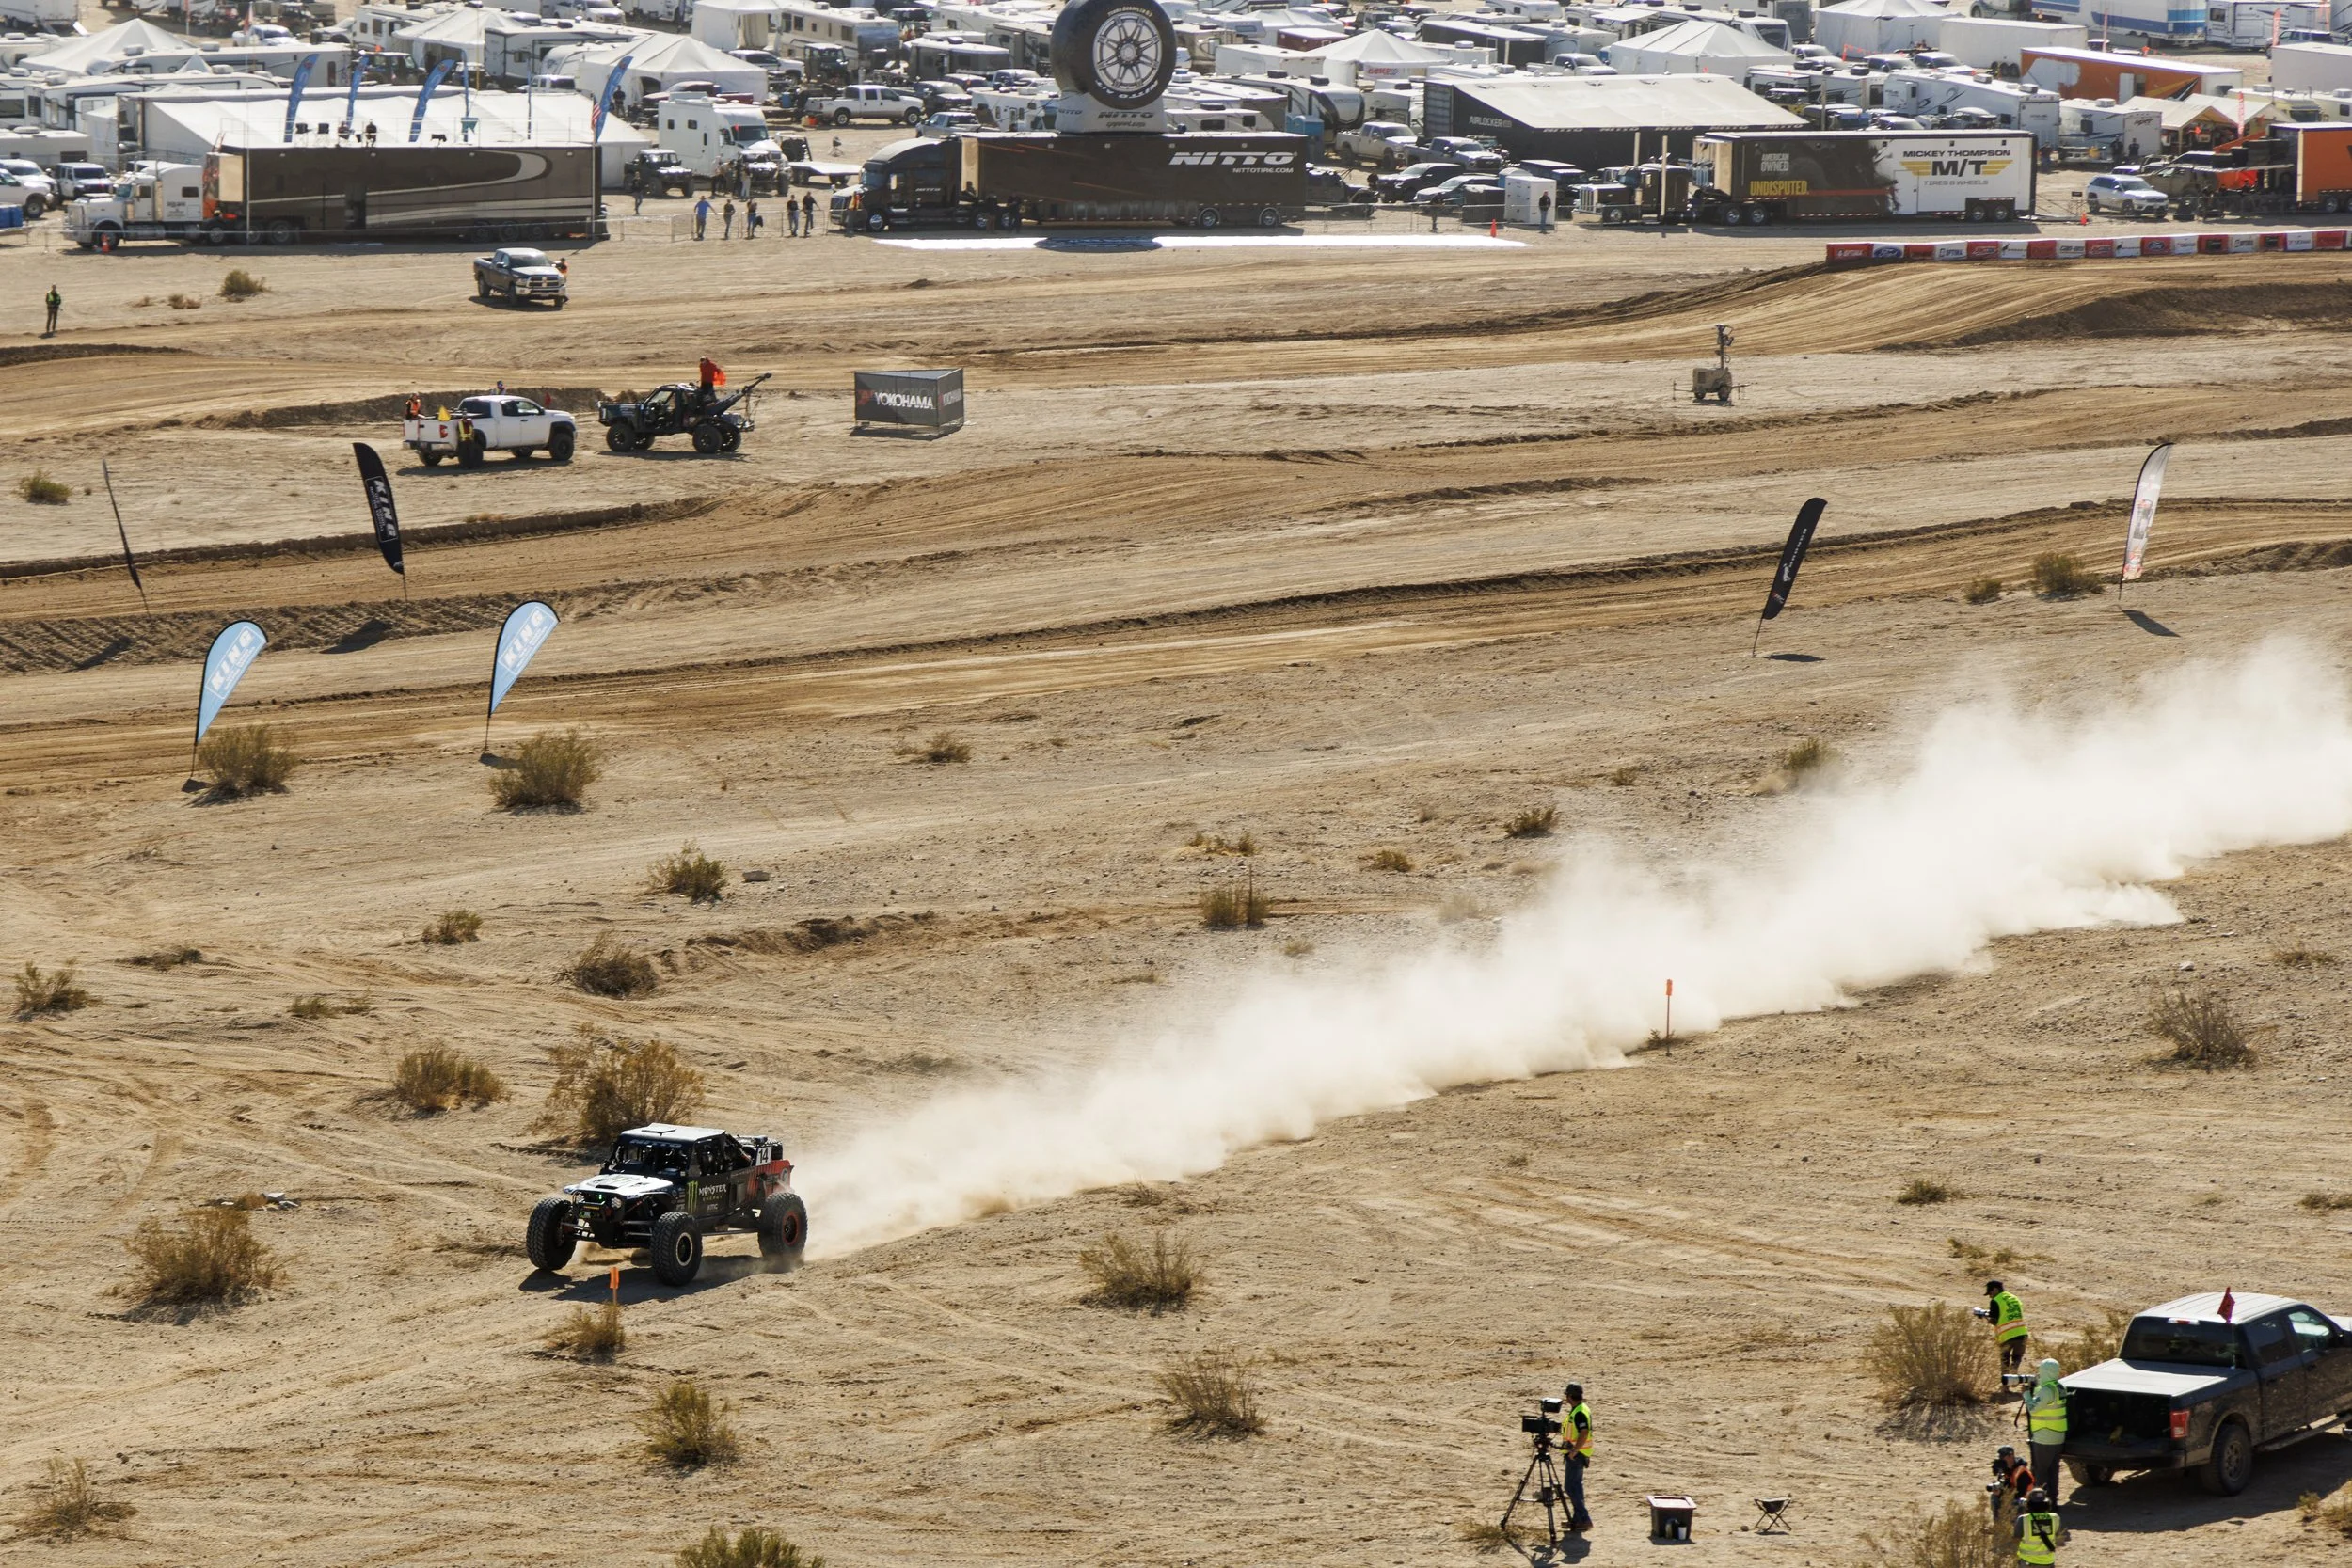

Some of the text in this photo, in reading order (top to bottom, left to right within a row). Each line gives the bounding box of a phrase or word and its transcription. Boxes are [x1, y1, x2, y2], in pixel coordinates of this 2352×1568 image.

[1168, 151, 1295, 166] NITTO
[1760, 161, 1789, 172] OWNED
[1931, 159, 1987, 177] M/T
[874, 391, 935, 409] YOKOHAMA
[373, 480, 396, 537] KING
[503, 610, 544, 669] KING
[211, 629, 253, 691] KING
[758, 1148, 769, 1164] 14
[698, 1183, 727, 1196] MONSTER
